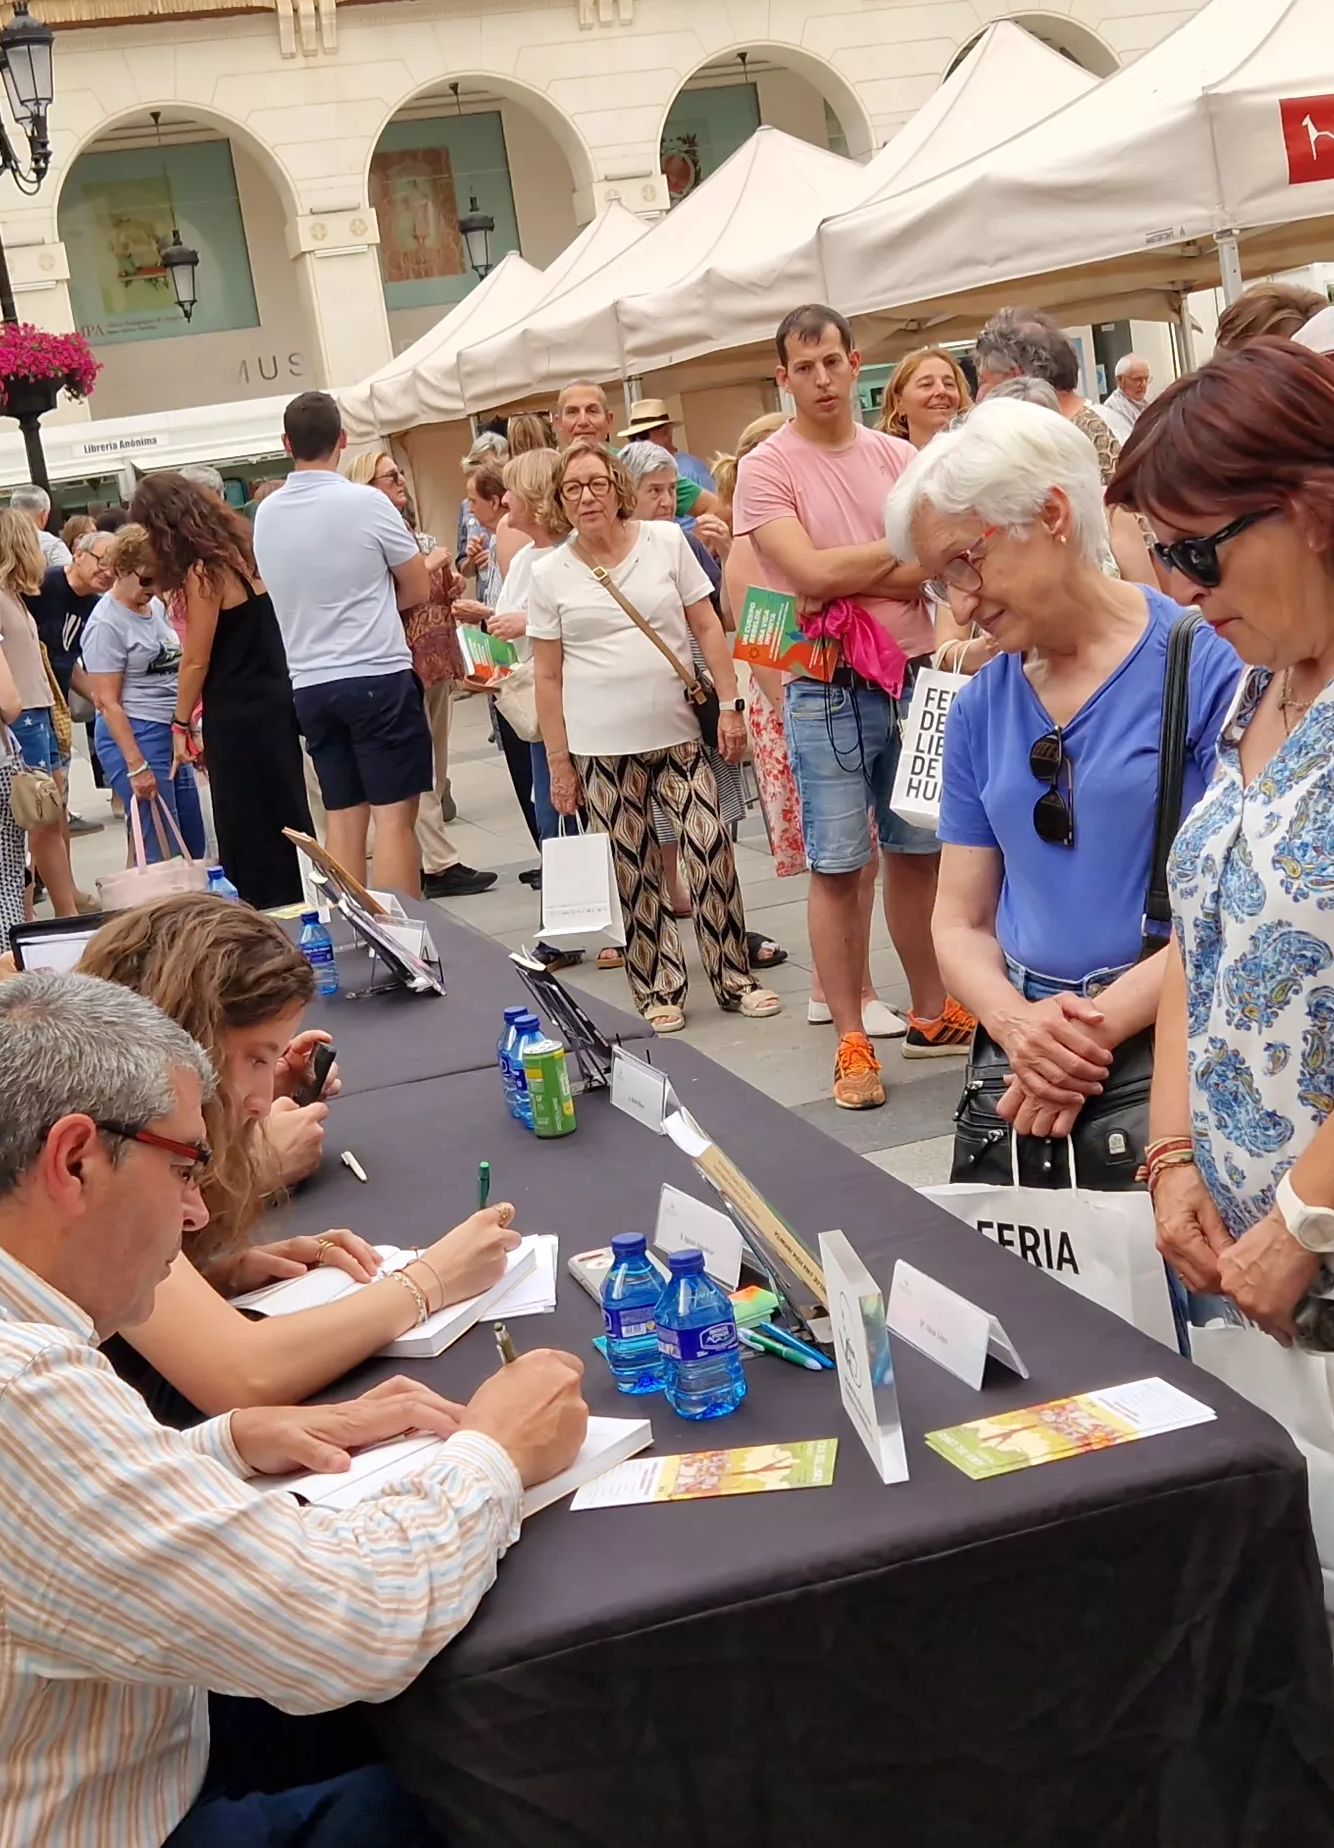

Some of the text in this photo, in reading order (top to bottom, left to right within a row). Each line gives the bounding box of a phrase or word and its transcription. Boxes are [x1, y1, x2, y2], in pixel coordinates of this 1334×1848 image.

[84, 435, 158, 454] Librería Anónima
[924, 687, 957, 711] FE
[910, 755, 939, 779] DE
[906, 777, 943, 803] HU
